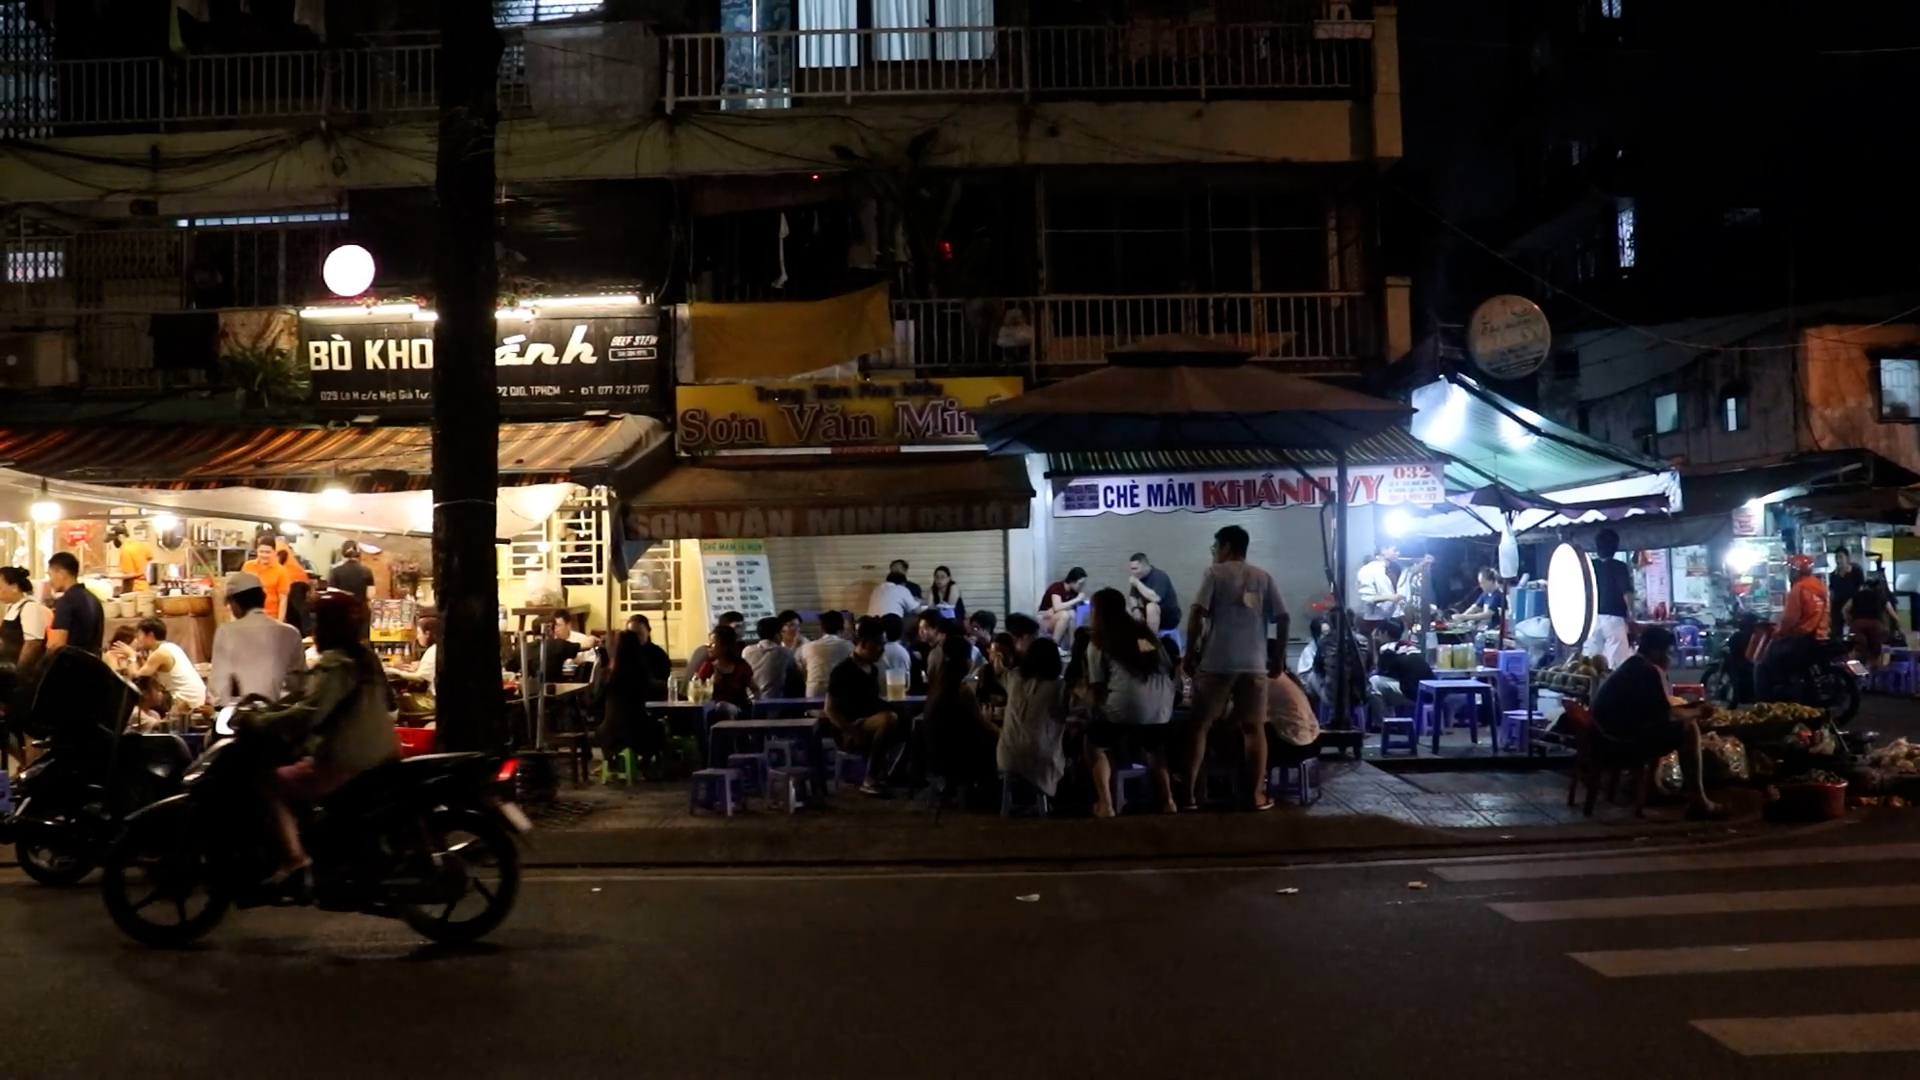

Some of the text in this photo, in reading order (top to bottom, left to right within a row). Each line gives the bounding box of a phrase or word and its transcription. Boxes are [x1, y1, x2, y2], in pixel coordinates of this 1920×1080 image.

[308, 334, 352, 371] BÒ
[364, 338, 434, 370] KHO
[610, 335, 633, 346] BEEF
[680, 409, 765, 446] Sơn
[780, 404, 878, 443] Văn
[1393, 464, 1432, 480] 032
[1103, 480, 1140, 508] CHÈ
[1147, 478, 1196, 508] MÂM
[806, 501, 911, 539] MINH
